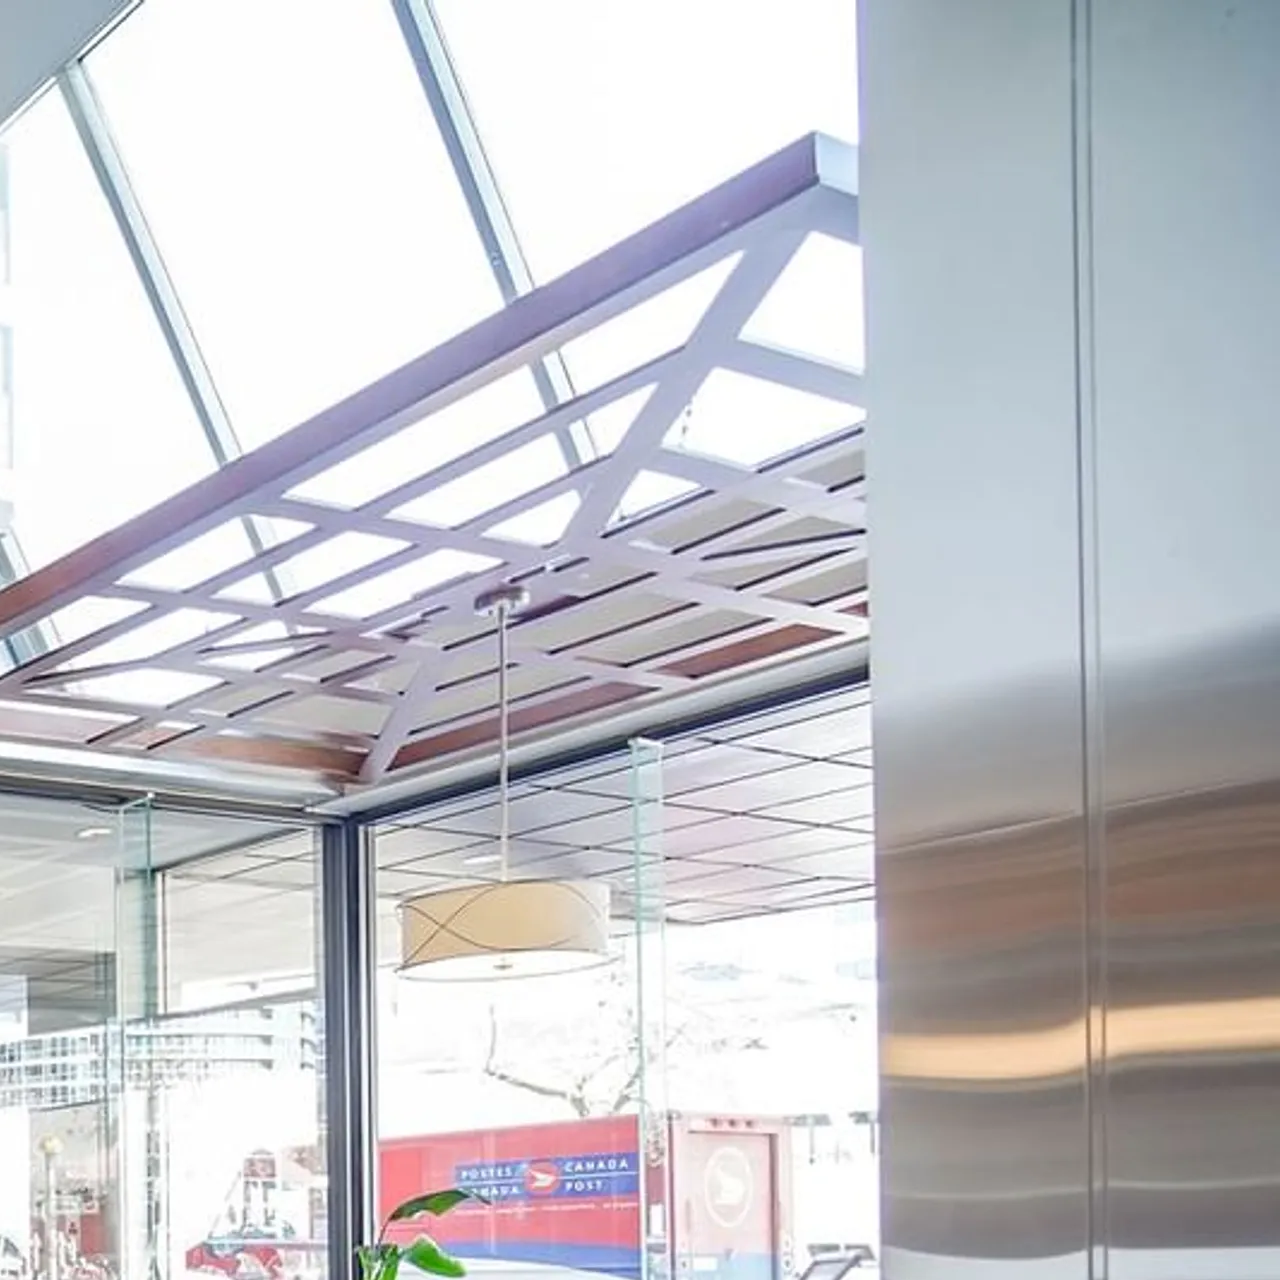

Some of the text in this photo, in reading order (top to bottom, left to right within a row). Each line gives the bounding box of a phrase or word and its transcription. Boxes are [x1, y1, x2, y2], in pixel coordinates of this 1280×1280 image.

[564, 1157, 628, 1172] CANADA
[461, 1167, 513, 1180] POSTES
[565, 1179, 603, 1192] POST
